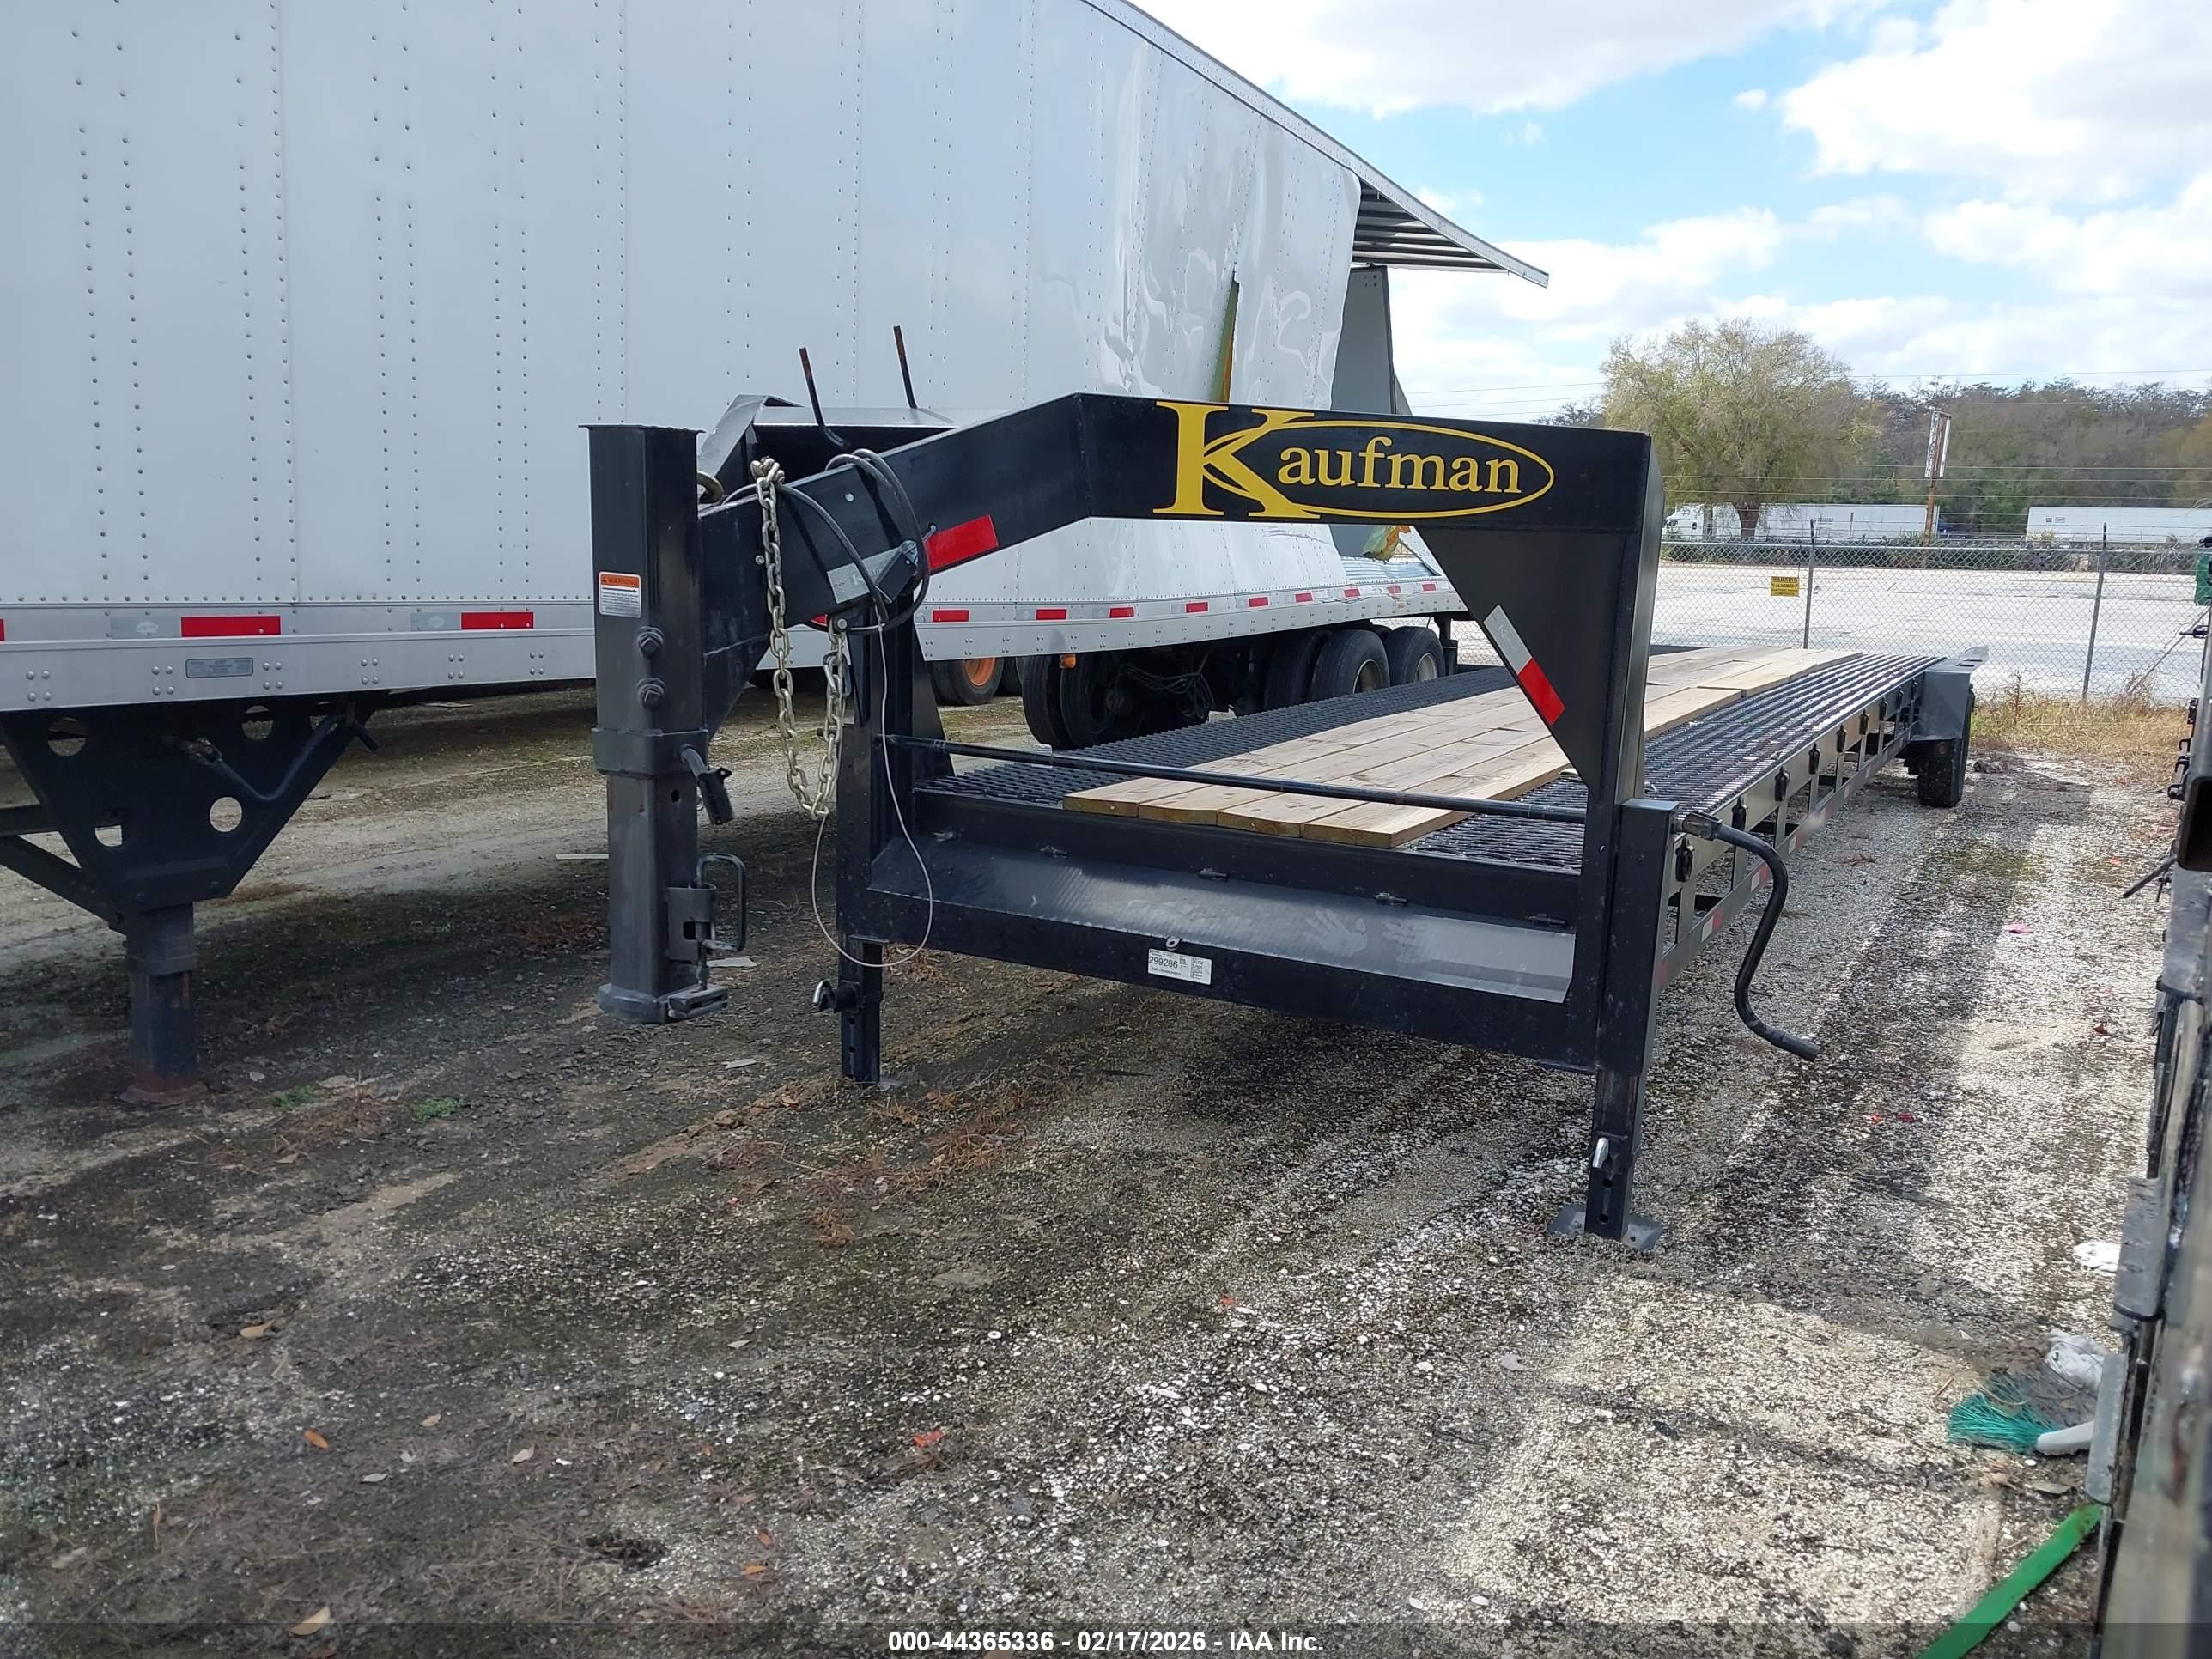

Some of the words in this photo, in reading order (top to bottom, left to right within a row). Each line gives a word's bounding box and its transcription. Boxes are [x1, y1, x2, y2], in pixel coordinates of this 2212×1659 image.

[1152, 401, 1522, 520] Kaufman
[607, 577, 638, 586] WARNING
[1149, 956, 1178, 969] 299286
